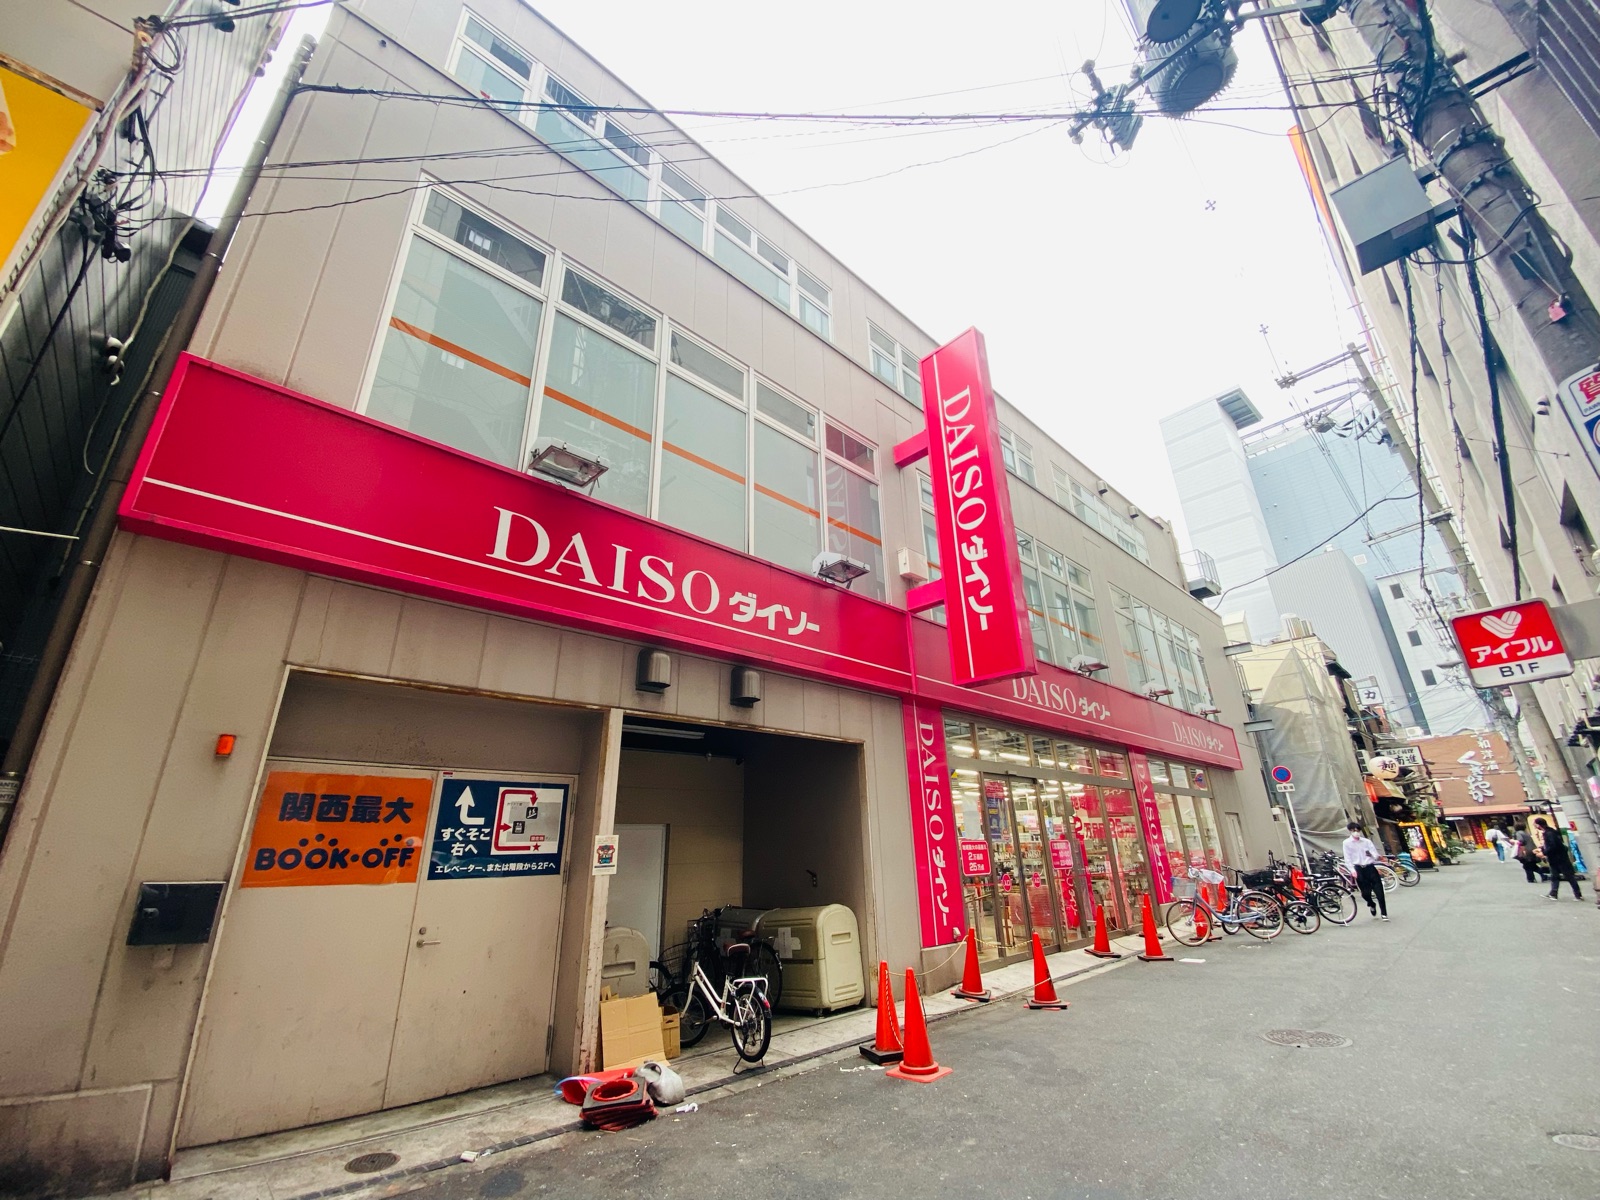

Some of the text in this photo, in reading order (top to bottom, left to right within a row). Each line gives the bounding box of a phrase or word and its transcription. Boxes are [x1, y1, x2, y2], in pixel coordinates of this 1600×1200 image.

[942, 384, 994, 631] DAISO ダイソー
[485, 505, 821, 635] DAISO ダイソー
[1470, 635, 1554, 664] アイフル
[1498, 661, 1540, 678] B1F
[1012, 676, 1111, 721] DAISO ダイソー
[1172, 721, 1207, 749] DAISO
[278, 791, 414, 824] 関西最大
[1137, 763, 1159, 840] DAISO
[440, 827, 491, 842] すぐそこ
[919, 722, 950, 927] DAISO ダイソー
[449, 843, 479, 856] 右へ
